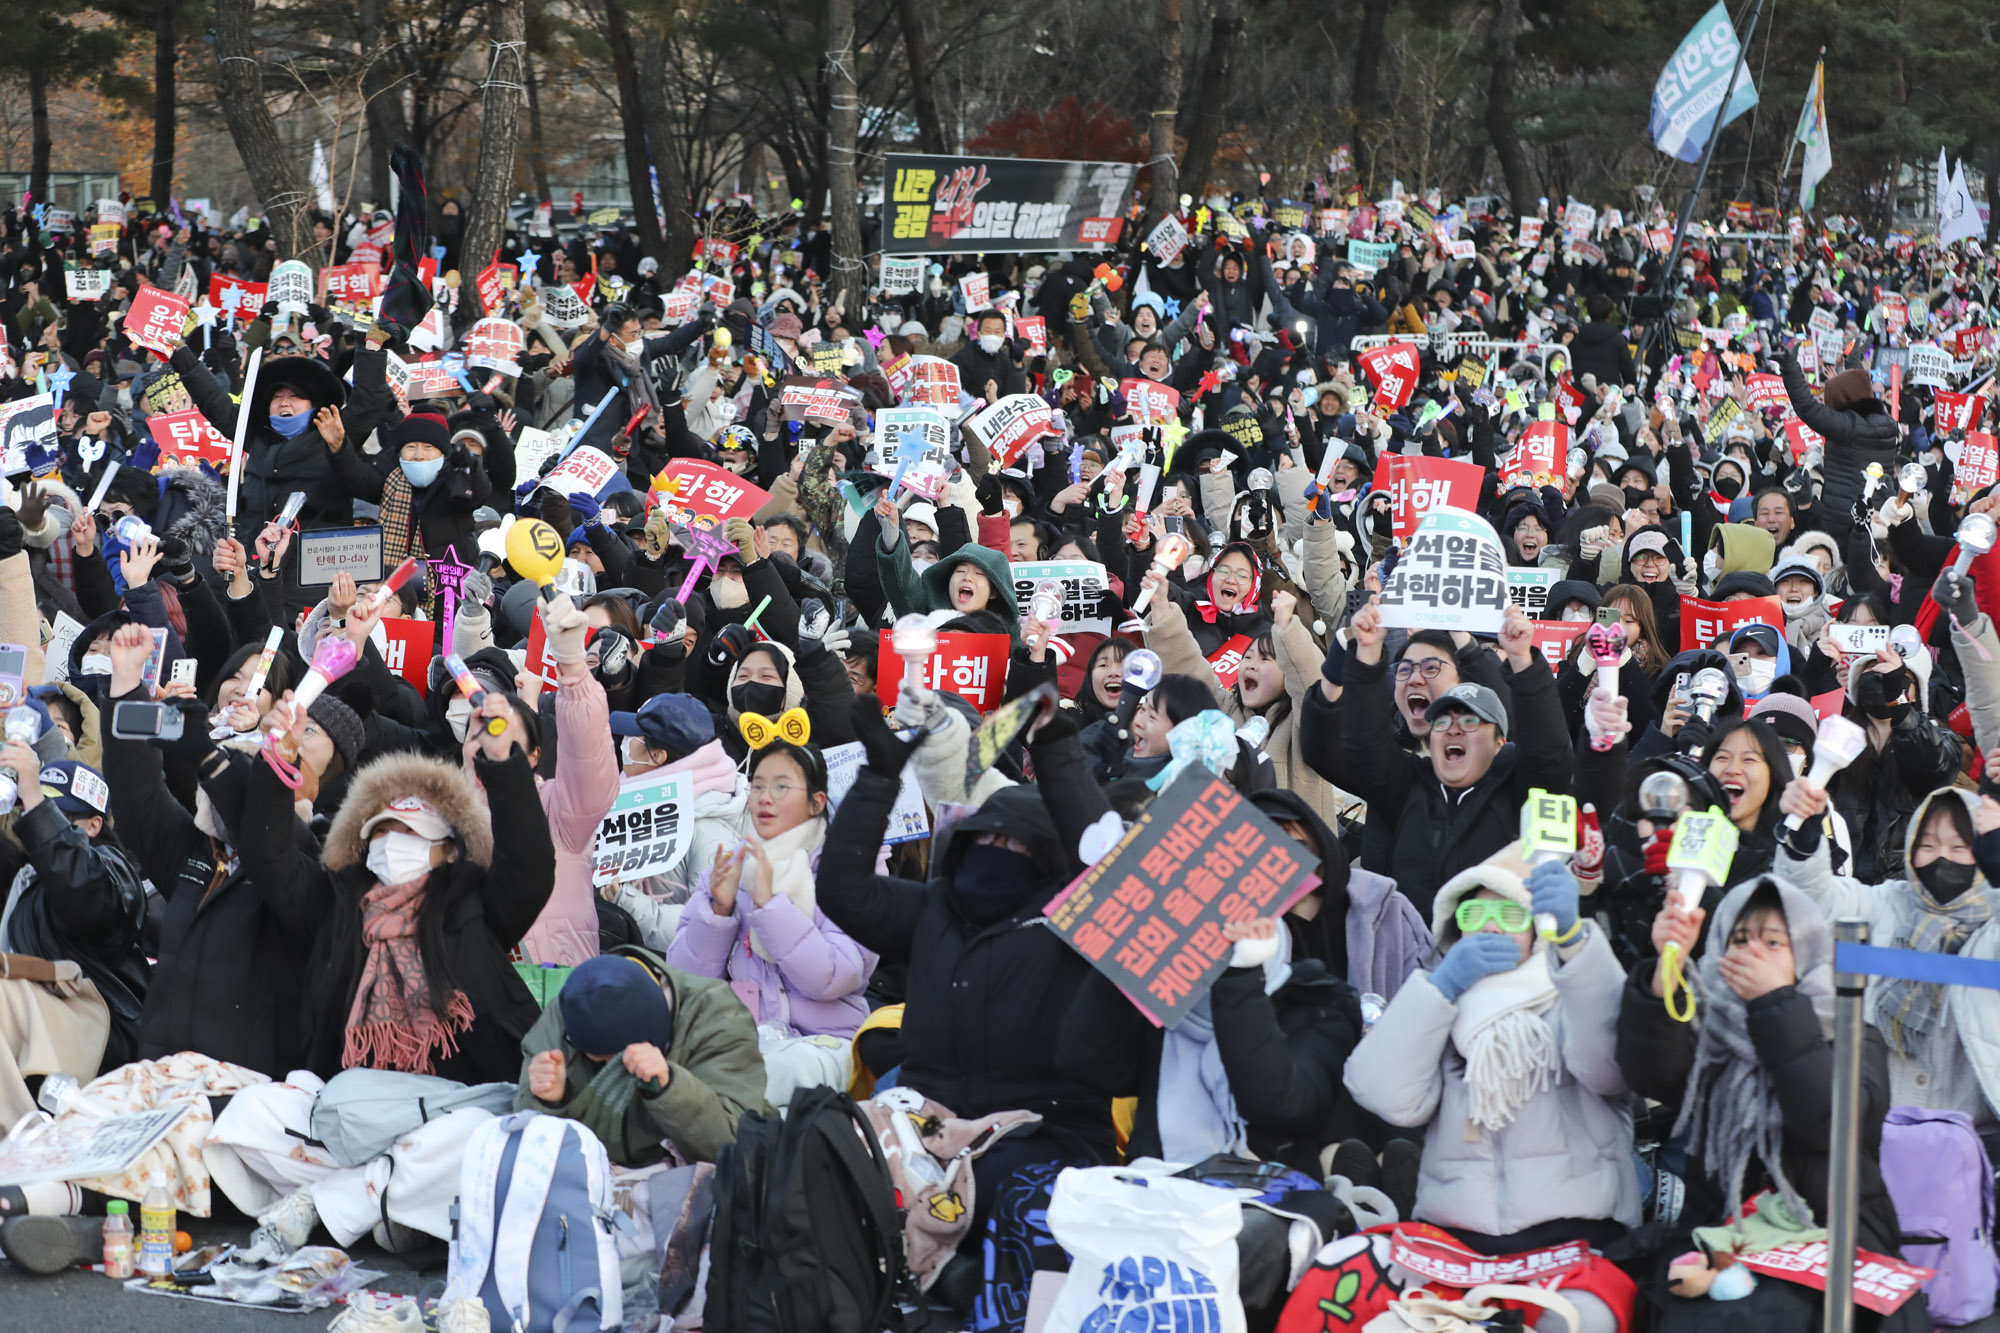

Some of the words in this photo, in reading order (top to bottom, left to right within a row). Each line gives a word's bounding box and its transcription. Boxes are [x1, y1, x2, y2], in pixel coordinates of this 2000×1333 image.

[893, 204, 931, 239] 공범
[328, 274, 370, 298] 탄핵
[464, 323, 522, 345] 석열을
[782, 393, 841, 406] 사건에서
[804, 405, 849, 421] 손떼라
[169, 419, 233, 457] 탄핵
[982, 397, 1042, 441] 내란수괴
[993, 420, 1030, 457] 윤석열
[1503, 434, 1556, 473] 탄핵
[571, 450, 613, 477] 윤석열
[675, 473, 745, 515] 탄핵
[316, 554, 336, 566] 탄핵
[339, 554, 369, 565] D-day
[1014, 577, 1103, 603] 윤열을
[1379, 572, 1508, 611] 탄핵하라
[1139, 778, 1242, 887] 못버리고
[1538, 797, 1571, 843] 탄
[591, 838, 677, 879] 핵하라
[1115, 914, 1180, 979] 집회
[1162, 820, 1267, 928] 올출하는
[1147, 920, 1234, 1007] 케이팝
[1218, 844, 1300, 925] 응원단
